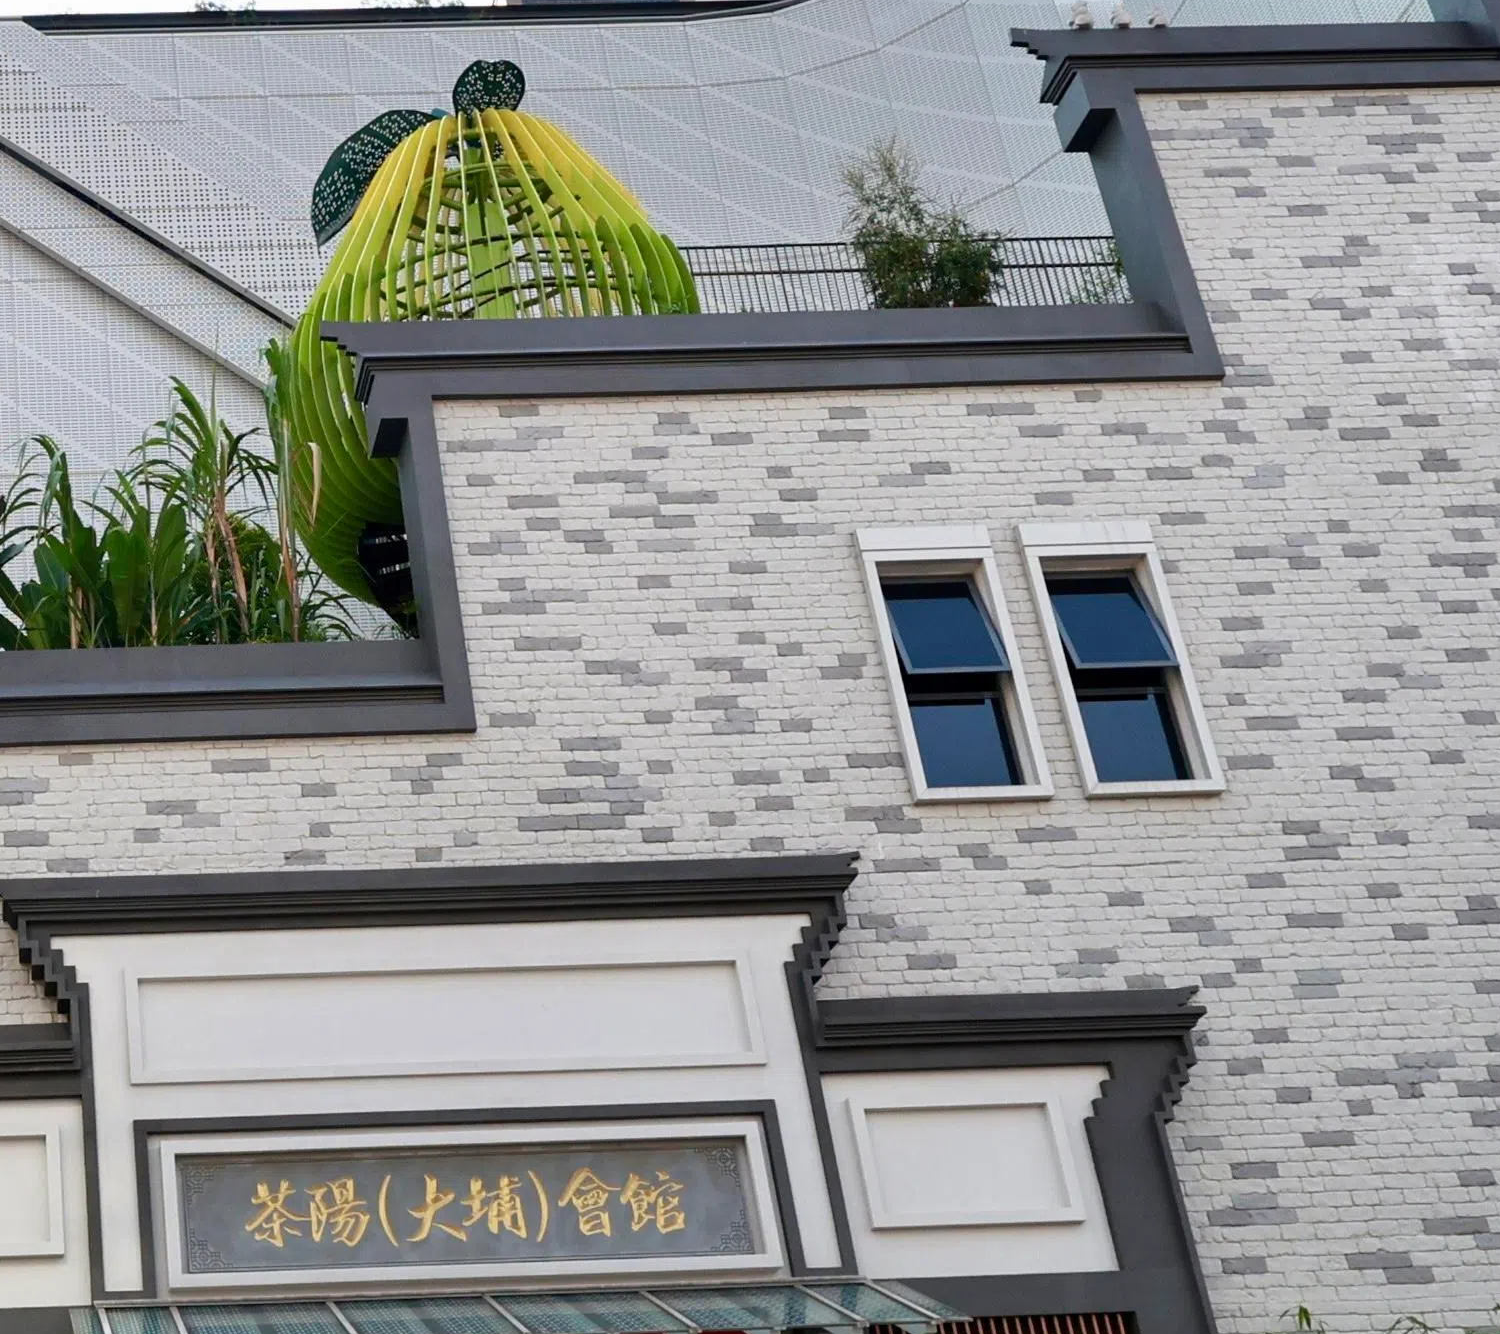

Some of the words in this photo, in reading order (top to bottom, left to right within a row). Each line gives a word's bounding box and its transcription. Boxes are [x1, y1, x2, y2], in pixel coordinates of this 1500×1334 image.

[244, 1166, 687, 1249] 茶陽(大埔)會館
